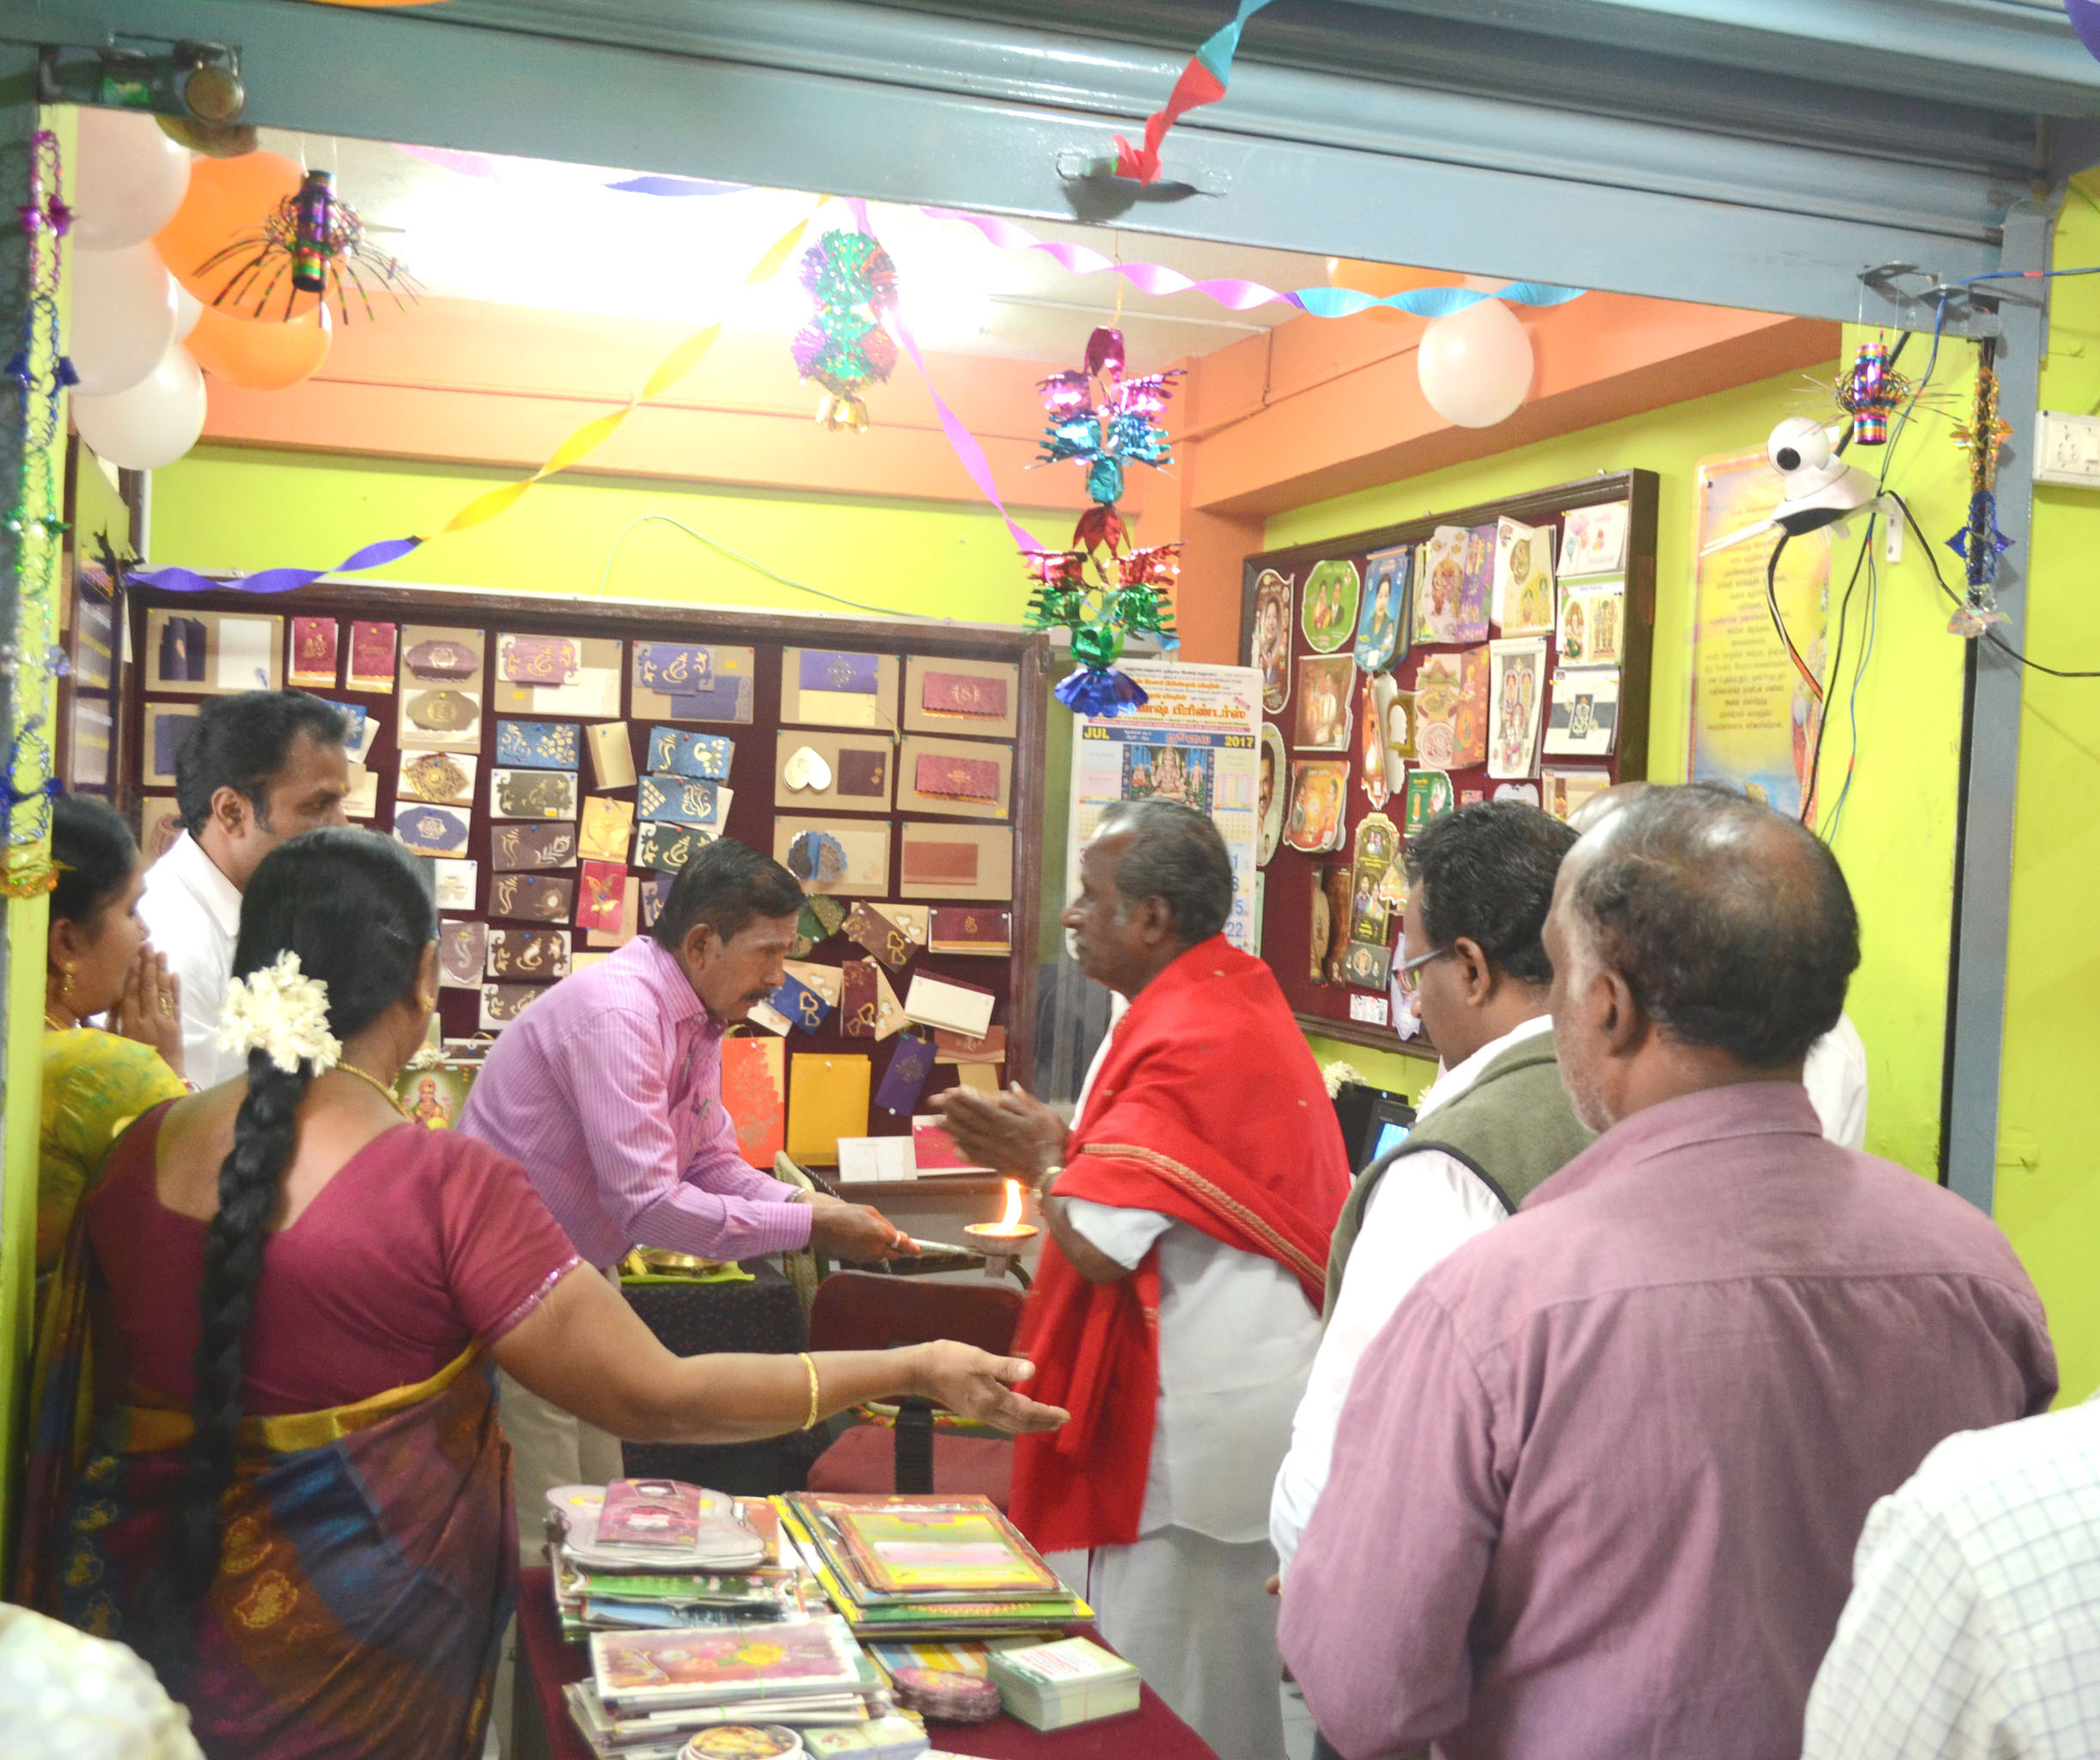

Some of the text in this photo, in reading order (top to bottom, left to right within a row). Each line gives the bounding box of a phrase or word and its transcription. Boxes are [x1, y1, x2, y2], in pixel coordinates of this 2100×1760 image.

[1084, 727, 1110, 740] JUL
[1224, 735, 1255, 748] 2017
[1226, 922, 1243, 938] 22
